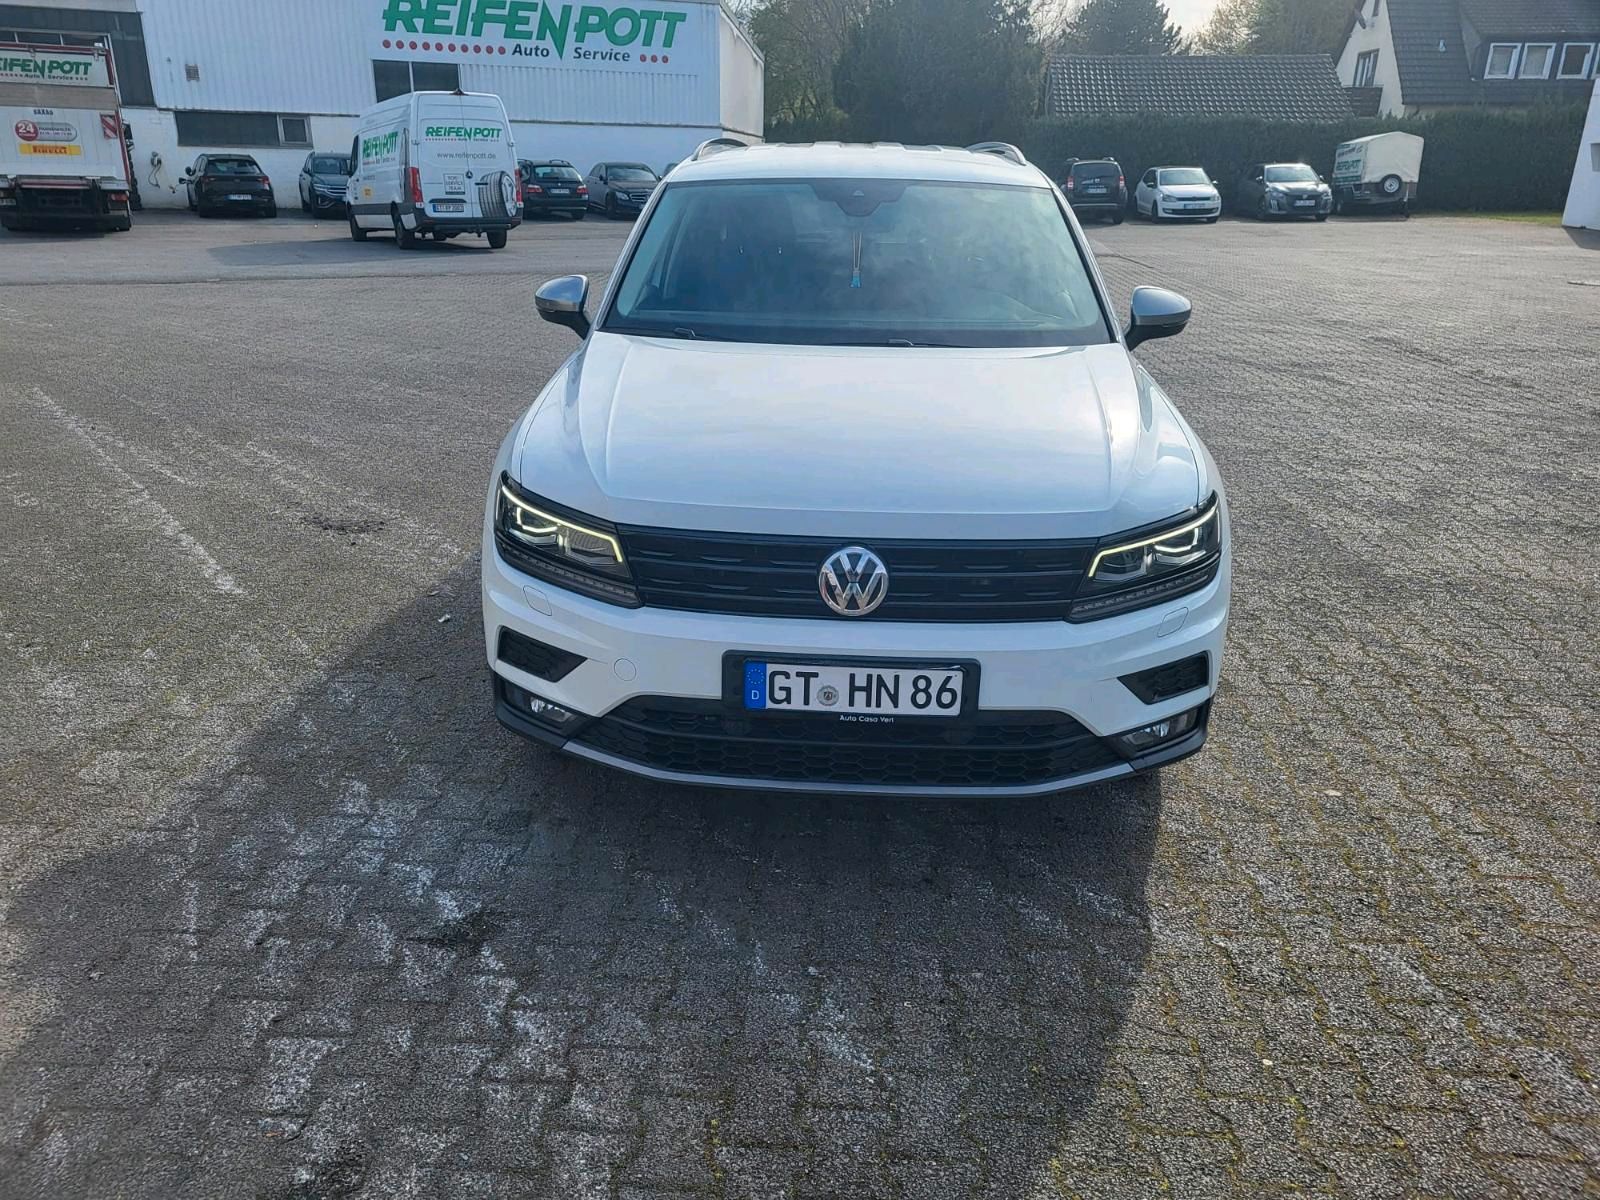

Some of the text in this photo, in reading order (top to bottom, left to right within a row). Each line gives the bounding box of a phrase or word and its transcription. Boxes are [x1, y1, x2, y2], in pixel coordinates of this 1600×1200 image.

[512, 44, 630, 61] Auto Service
[18, 123, 35, 133] 24
[751, 690, 760, 700] D
[768, 670, 958, 710] GT HN 86
[839, 714, 857, 722] Auto
[858, 715, 879, 723] Casa
